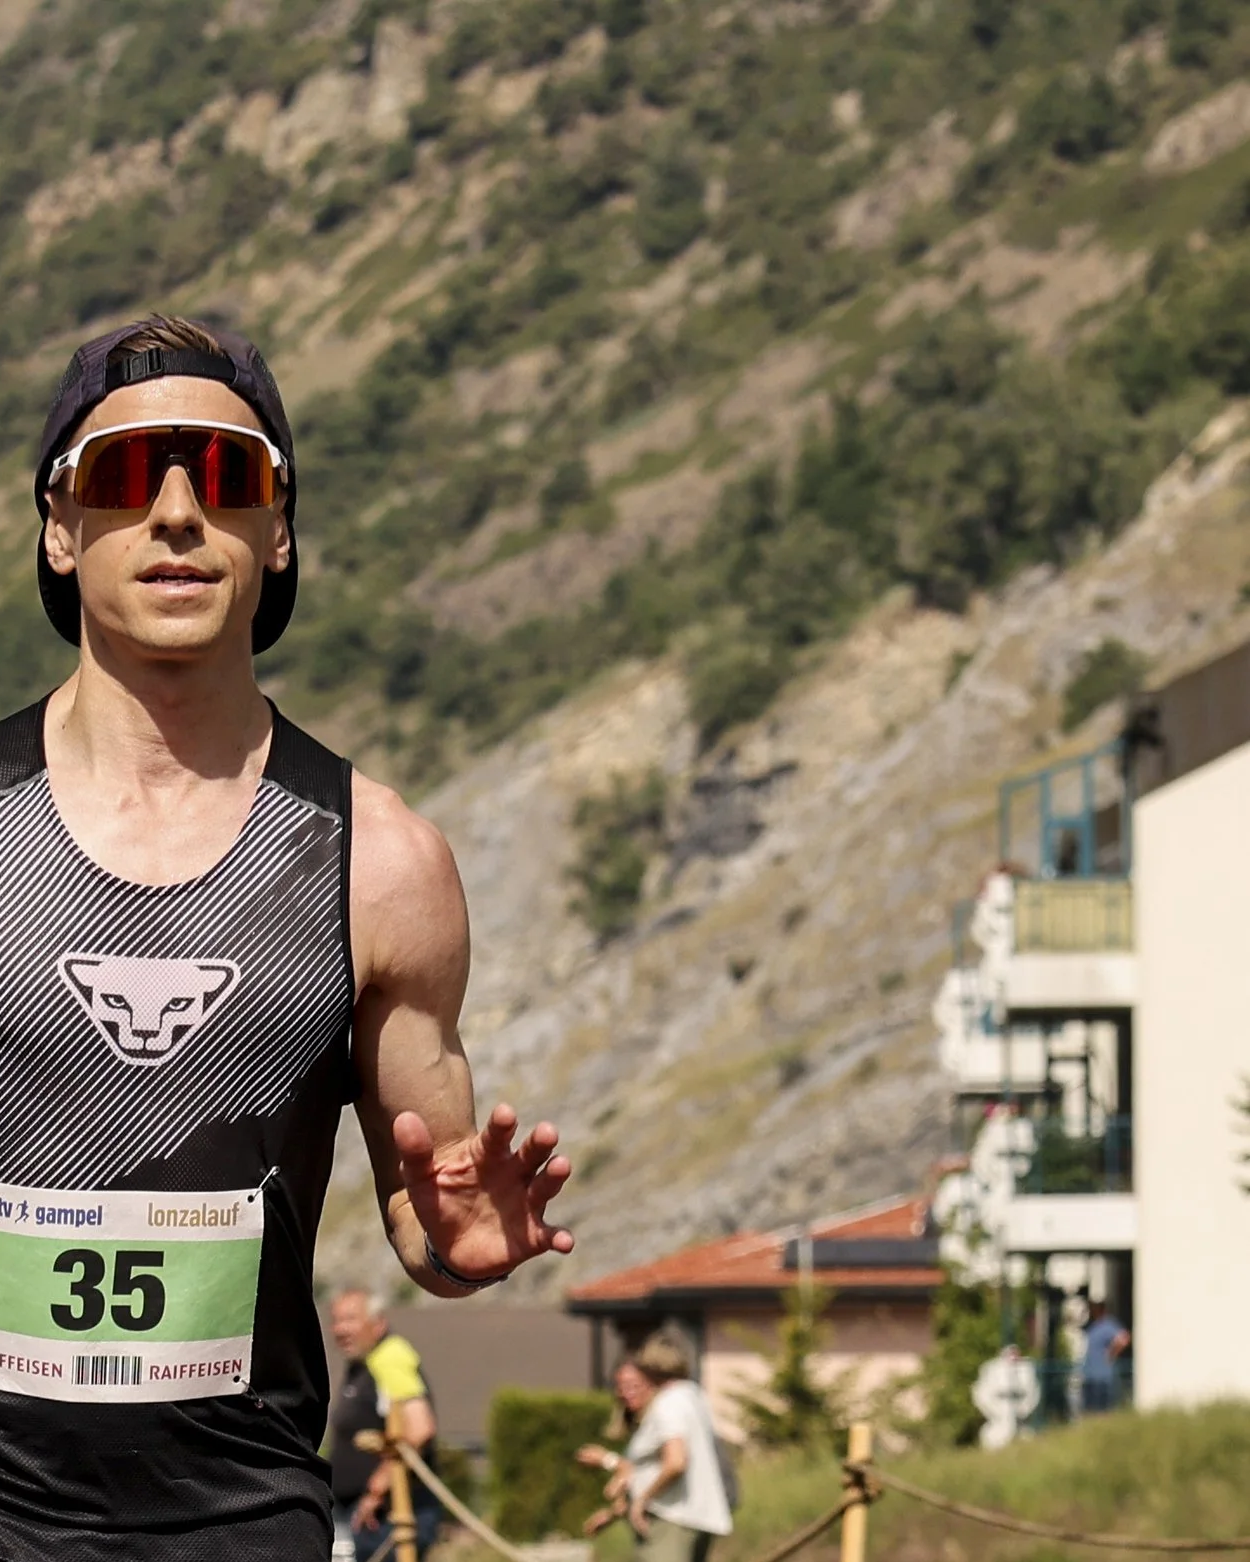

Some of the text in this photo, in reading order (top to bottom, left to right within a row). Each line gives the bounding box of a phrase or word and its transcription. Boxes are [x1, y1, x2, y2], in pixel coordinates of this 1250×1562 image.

[35, 1204, 103, 1227] gampel
[147, 1201, 240, 1228] lonzalauf
[50, 1248, 166, 1332] 35
[149, 1358, 243, 1380] RAIFFEISEN
